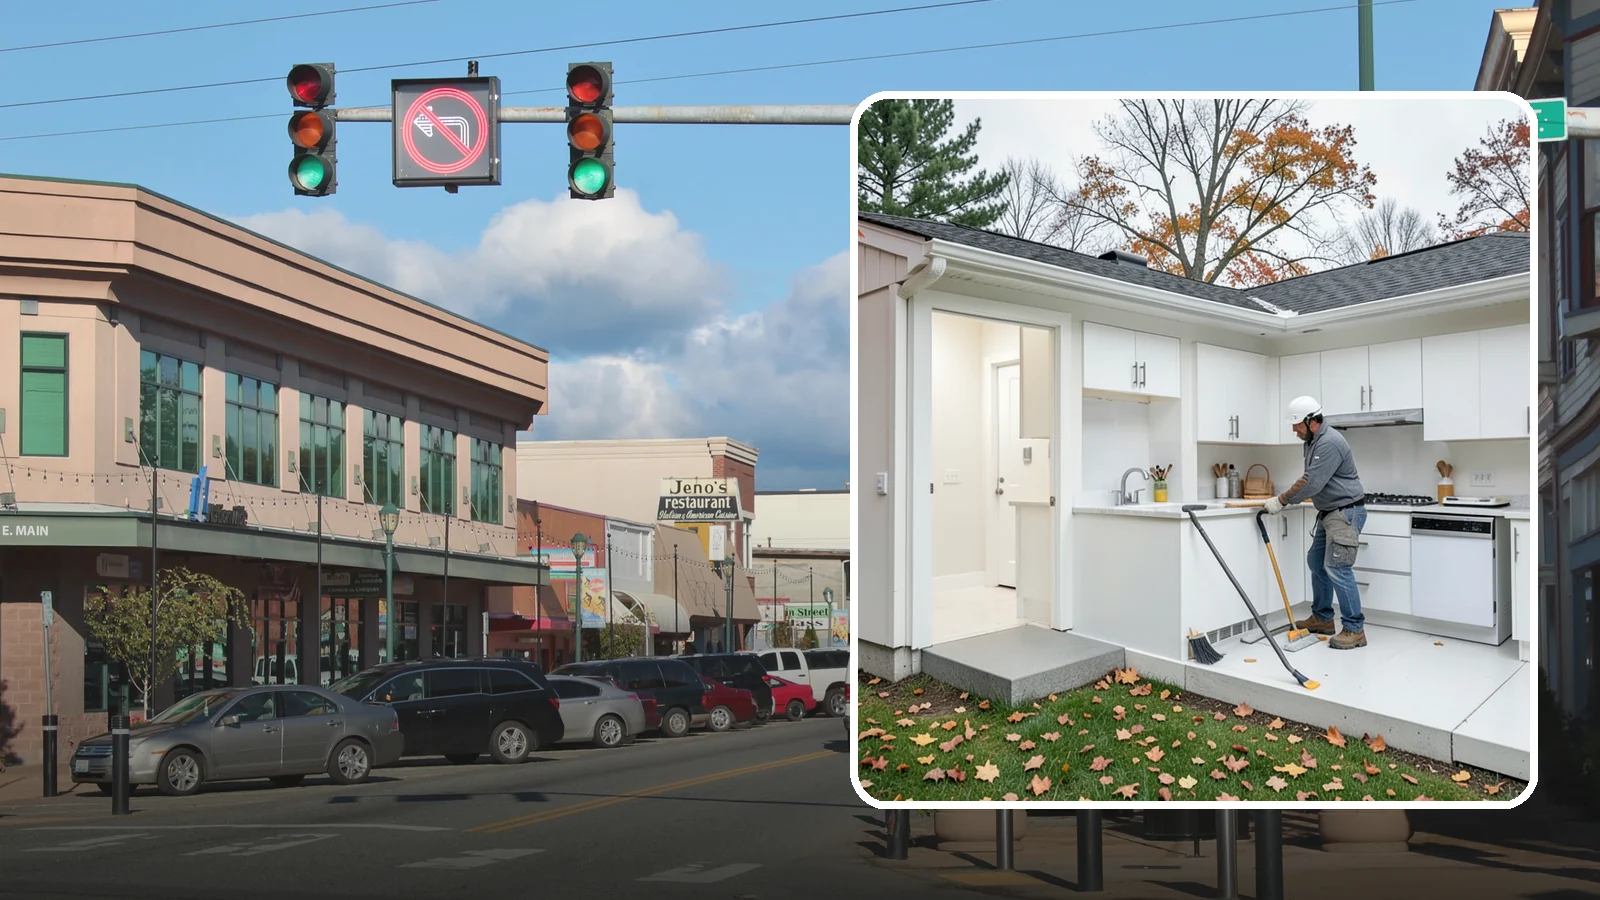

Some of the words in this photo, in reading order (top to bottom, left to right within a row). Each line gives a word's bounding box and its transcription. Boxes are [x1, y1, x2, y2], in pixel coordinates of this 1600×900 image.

[669, 479, 728, 495] Jeno's
[665, 496, 731, 509] restaurant
[658, 510, 681, 520] Italian
[686, 509, 715, 519] American
[715, 509, 737, 519] Cuisine
[2, 525, 13, 536] E.
[15, 525, 49, 536] MAIN
[797, 607, 829, 617] Street
